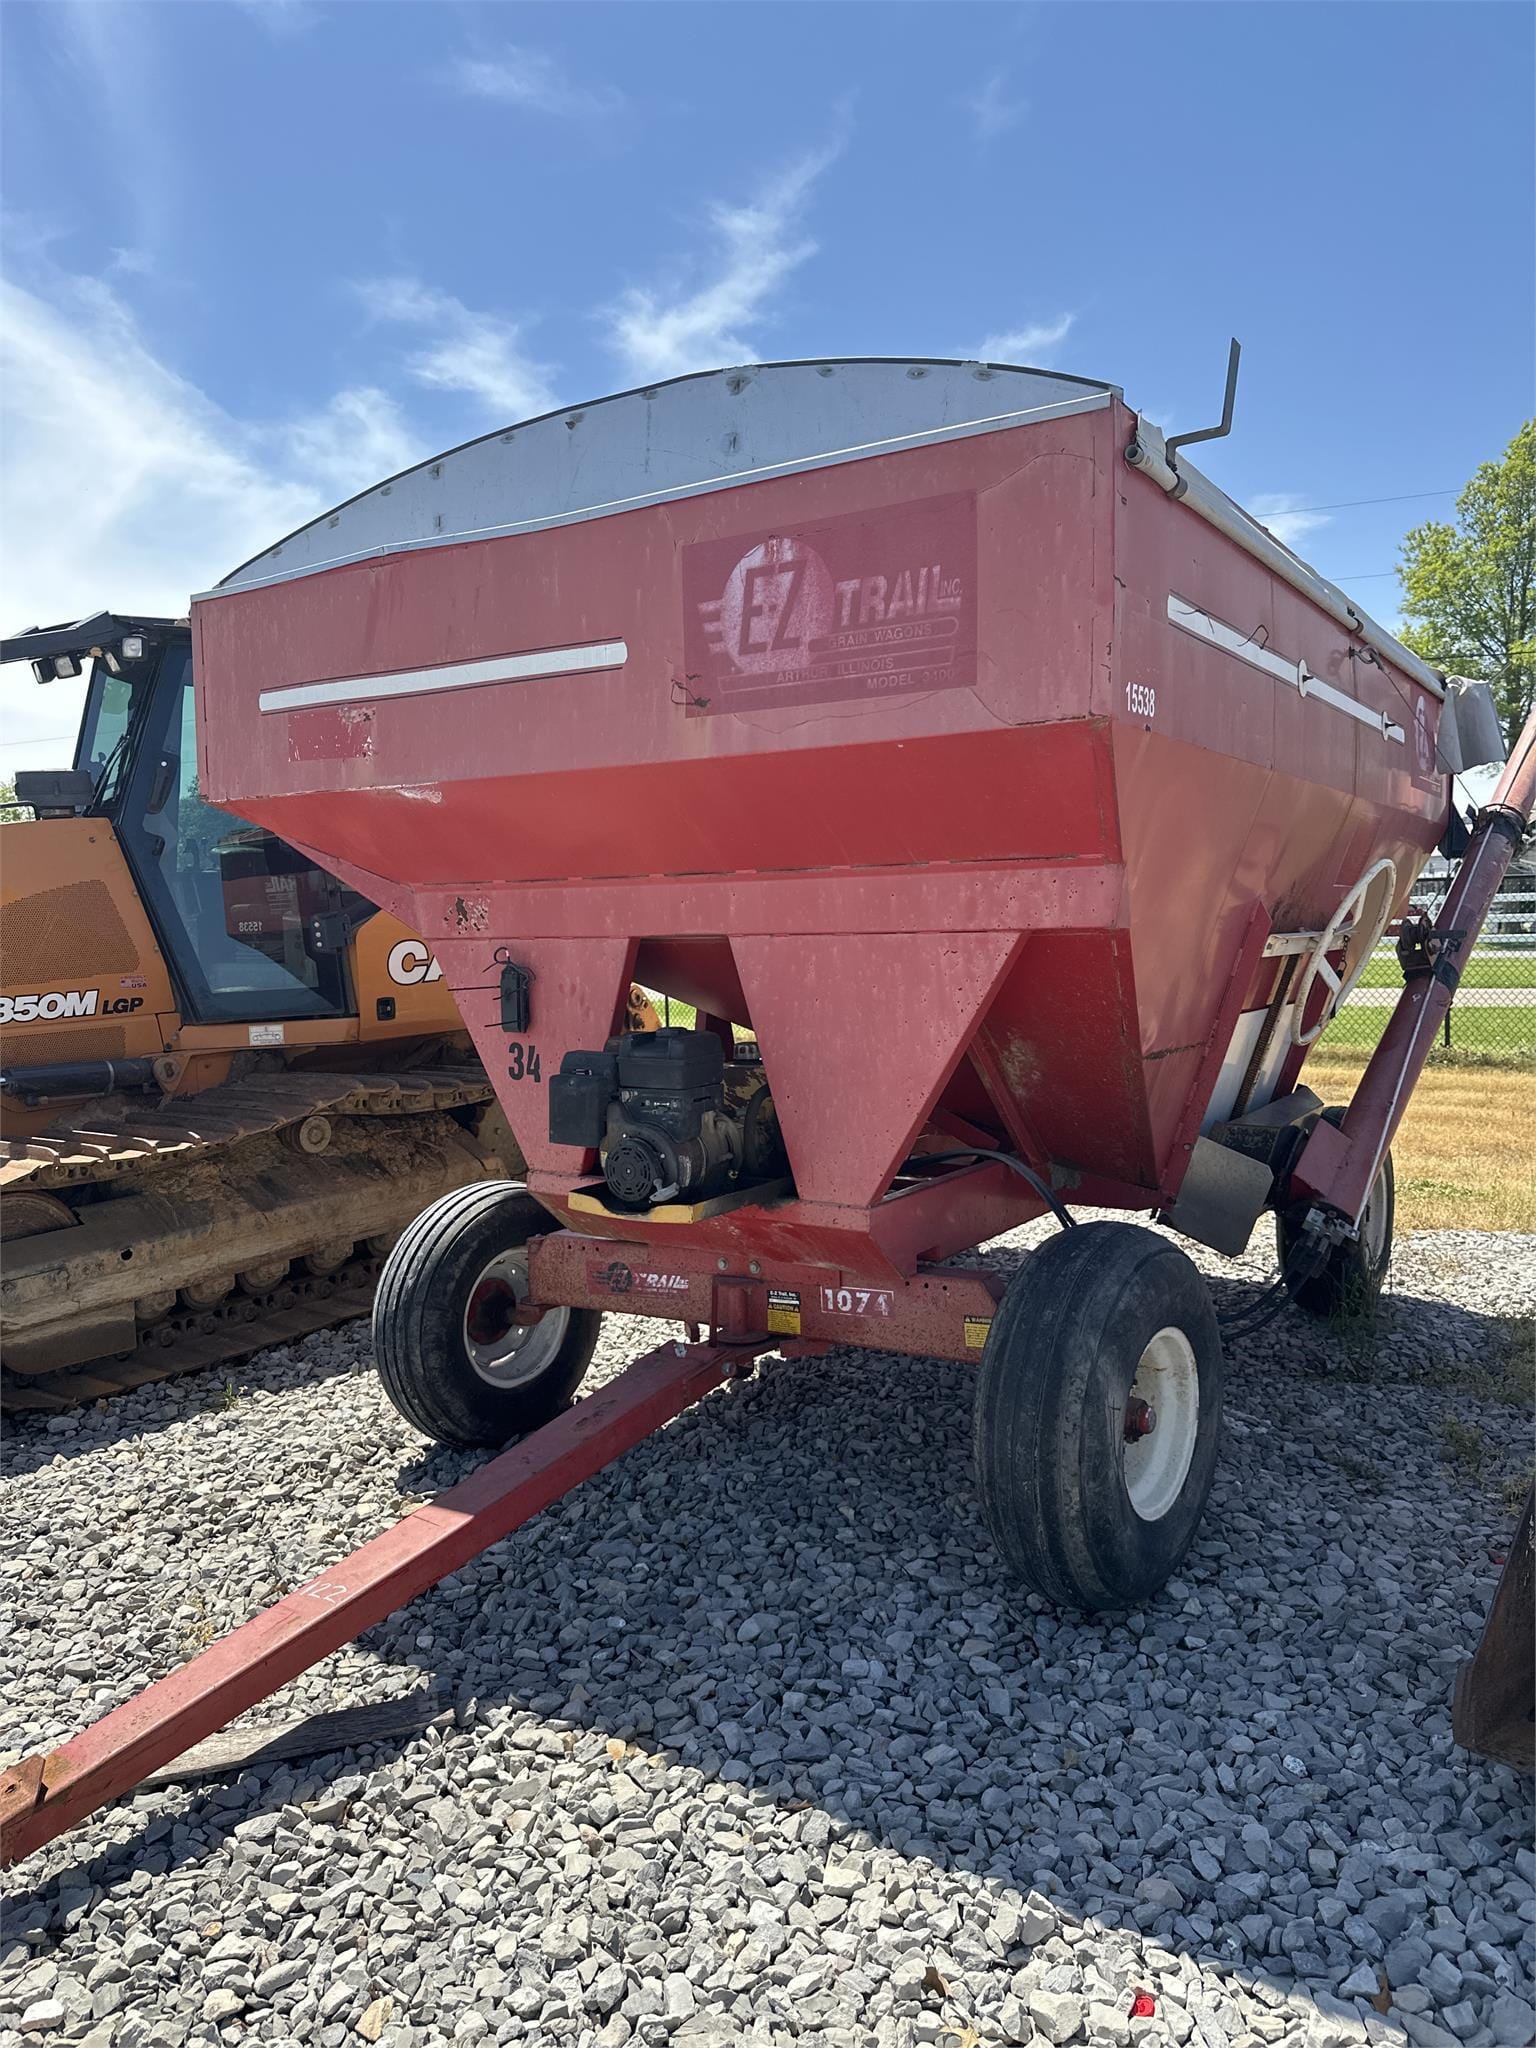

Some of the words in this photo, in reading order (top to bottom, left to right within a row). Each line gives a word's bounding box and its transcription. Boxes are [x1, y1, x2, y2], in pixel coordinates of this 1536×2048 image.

[836, 565, 961, 627] TRAIL
[830, 632, 868, 649] GRAIN
[874, 623, 932, 641] WAGONS
[776, 667, 828, 683] ARTHUR
[837, 657, 894, 676] ILLINOIS
[867, 673, 915, 689] MODEL
[1125, 681, 1155, 718] 15538
[102, 997, 144, 1015] LGP
[508, 1041, 541, 1083] 34
[824, 1288, 890, 1316] 1074
